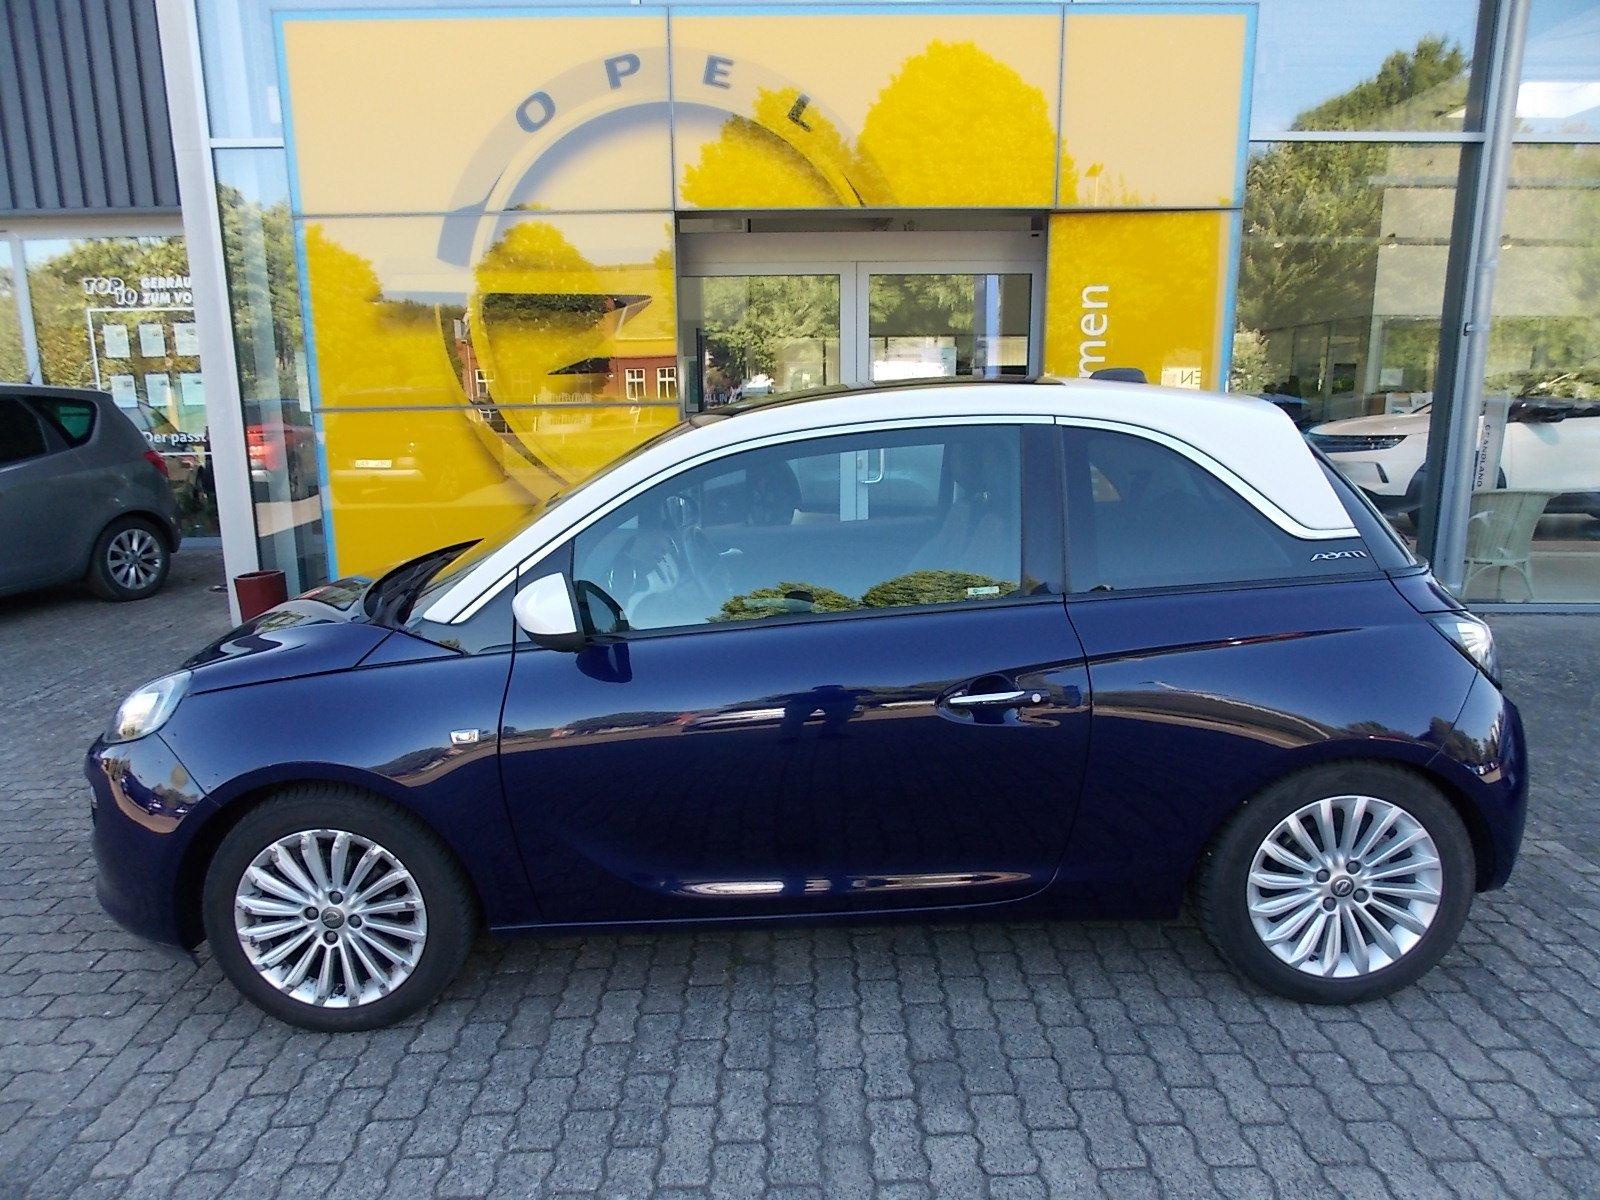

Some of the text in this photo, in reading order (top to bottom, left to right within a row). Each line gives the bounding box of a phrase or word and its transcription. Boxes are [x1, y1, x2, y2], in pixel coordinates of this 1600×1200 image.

[515, 52, 812, 133] OPEL
[83, 277, 125, 294] TOP
[115, 287, 137, 305] 10
[142, 292, 171, 304] ZUM
[1078, 285, 1109, 379] men
